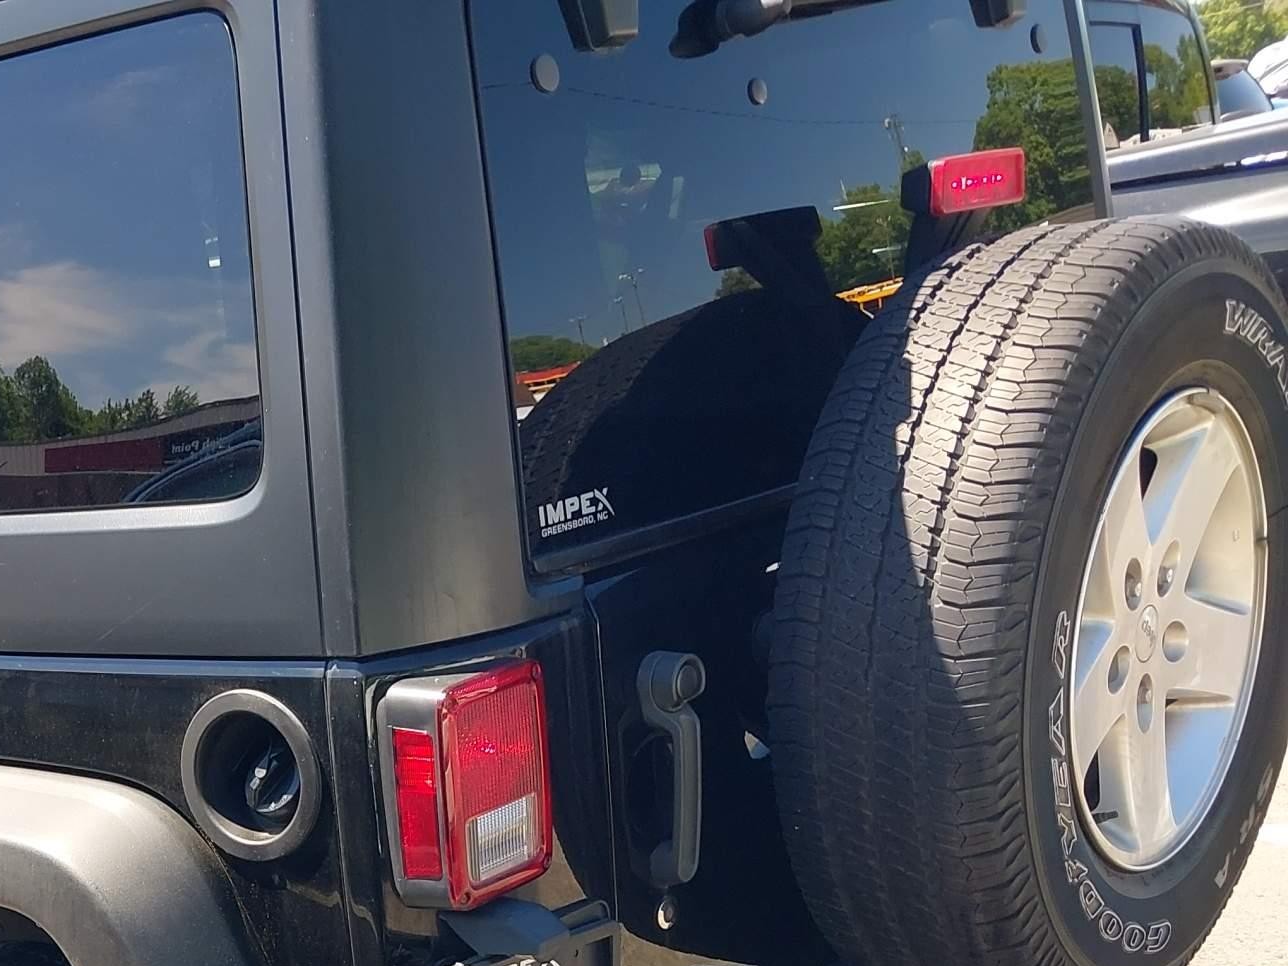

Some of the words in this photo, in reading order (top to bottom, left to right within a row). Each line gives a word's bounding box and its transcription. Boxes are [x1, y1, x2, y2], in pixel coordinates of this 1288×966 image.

[1225, 299, 1288, 411] WRA
[538, 487, 615, 528] IMPEX
[541, 515, 596, 538] GREENSBORO,
[597, 511, 609, 521] NC
[1048, 611, 1172, 953] GOODYEAR
